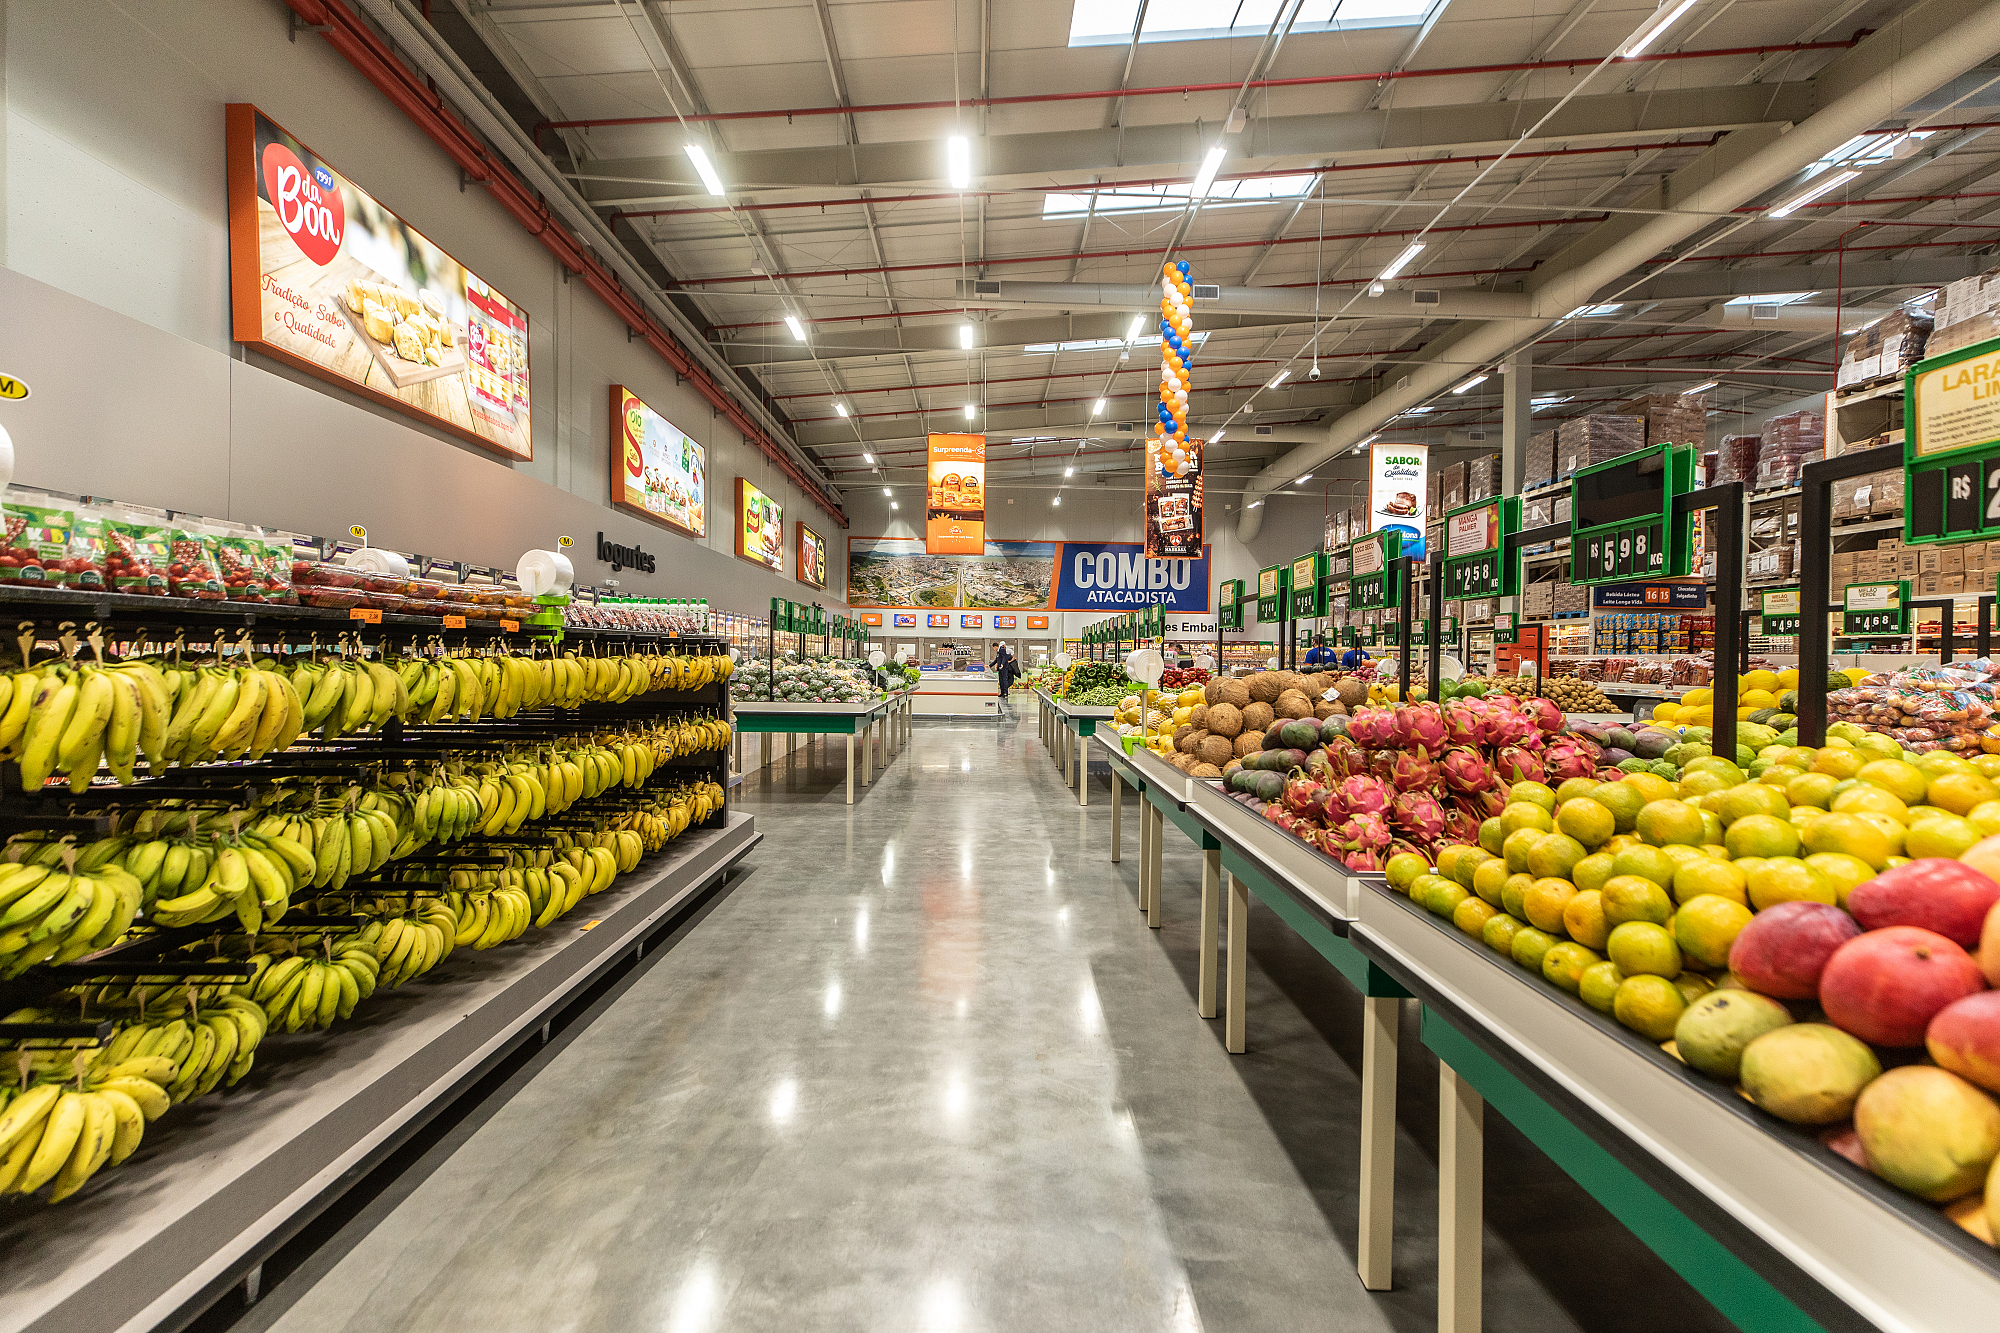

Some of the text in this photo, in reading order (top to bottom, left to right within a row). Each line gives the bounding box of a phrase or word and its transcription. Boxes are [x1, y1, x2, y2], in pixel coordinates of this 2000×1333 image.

[316, 170, 332, 187] 1991
[302, 174, 322, 205] da
[277, 165, 341, 246] Boa
[261, 273, 346, 330] Tradição, Sabor
[274, 311, 336, 348] e Qualidade
[0, 378, 14, 394] M
[1385, 456, 1420, 466] SABOR
[1384, 468, 1419, 478] Qualidade
[1952, 468, 2000, 520] R$ 2
[1458, 514, 1478, 526] MANGA
[354, 528, 362, 536] M
[1402, 530, 1418, 539] lona
[1458, 522, 1477, 534] PALMER
[563, 537, 570, 546] M
[597, 531, 656, 574] Iogurtes
[1590, 535, 1663, 572] R$ 5,98 KG
[1074, 552, 1192, 590] COMBO
[1464, 564, 1489, 591] 2,58
[1491, 578, 1498, 588] KG
[1086, 590, 1177, 604] ATACADISTA
[1646, 591, 1669, 600] 16 15
[1166, 624, 1178, 632] es
[1779, 620, 1800, 632] 4,98
[1864, 615, 1889, 630] 4,68
